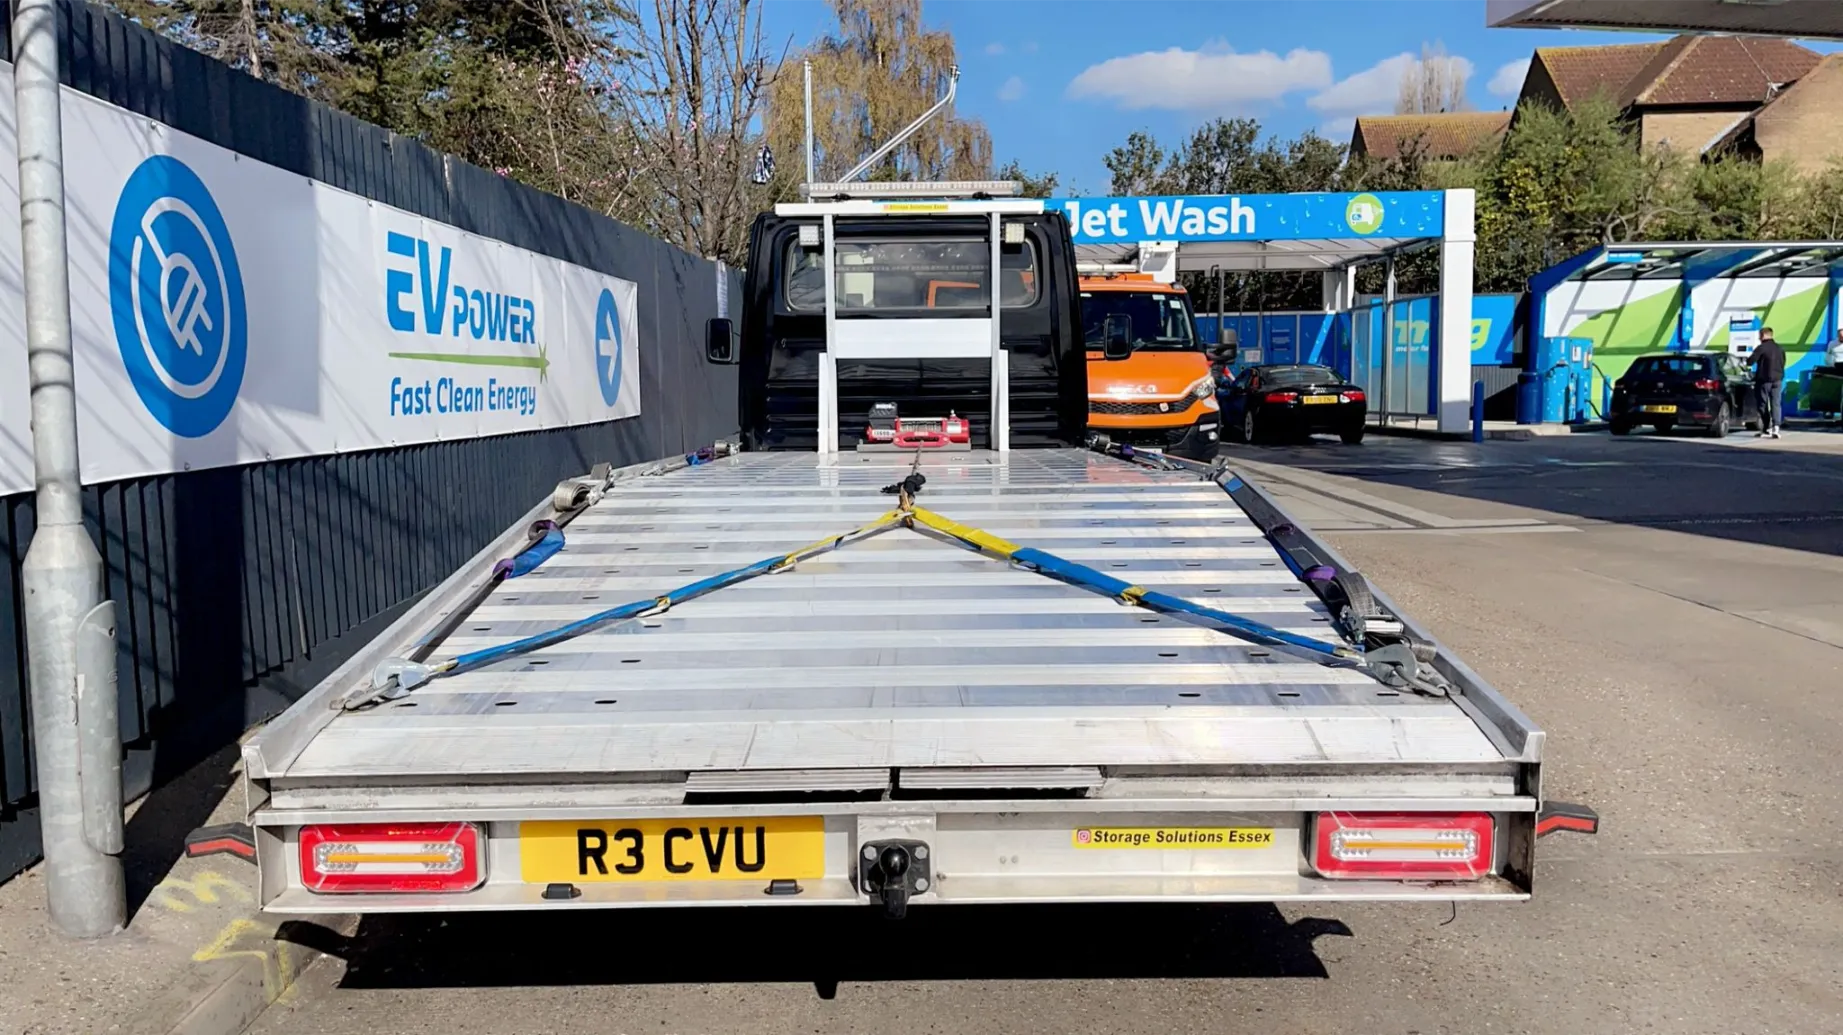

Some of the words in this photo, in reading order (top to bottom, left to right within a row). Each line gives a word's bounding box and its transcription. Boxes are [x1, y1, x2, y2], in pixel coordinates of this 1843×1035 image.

[1065, 200, 1128, 238] Jet
[1138, 198, 1255, 236] Wash
[387, 230, 452, 335] EV
[453, 285, 535, 344] POWER
[391, 377, 431, 416] Fast
[437, 377, 484, 413] Clean
[488, 378, 536, 416] Energy
[577, 828, 645, 875] R3
[664, 826, 765, 874] CVU
[1094, 830, 1150, 845] Storage
[1156, 830, 1223, 843] Solutions
[1229, 830, 1271, 843] Essex
